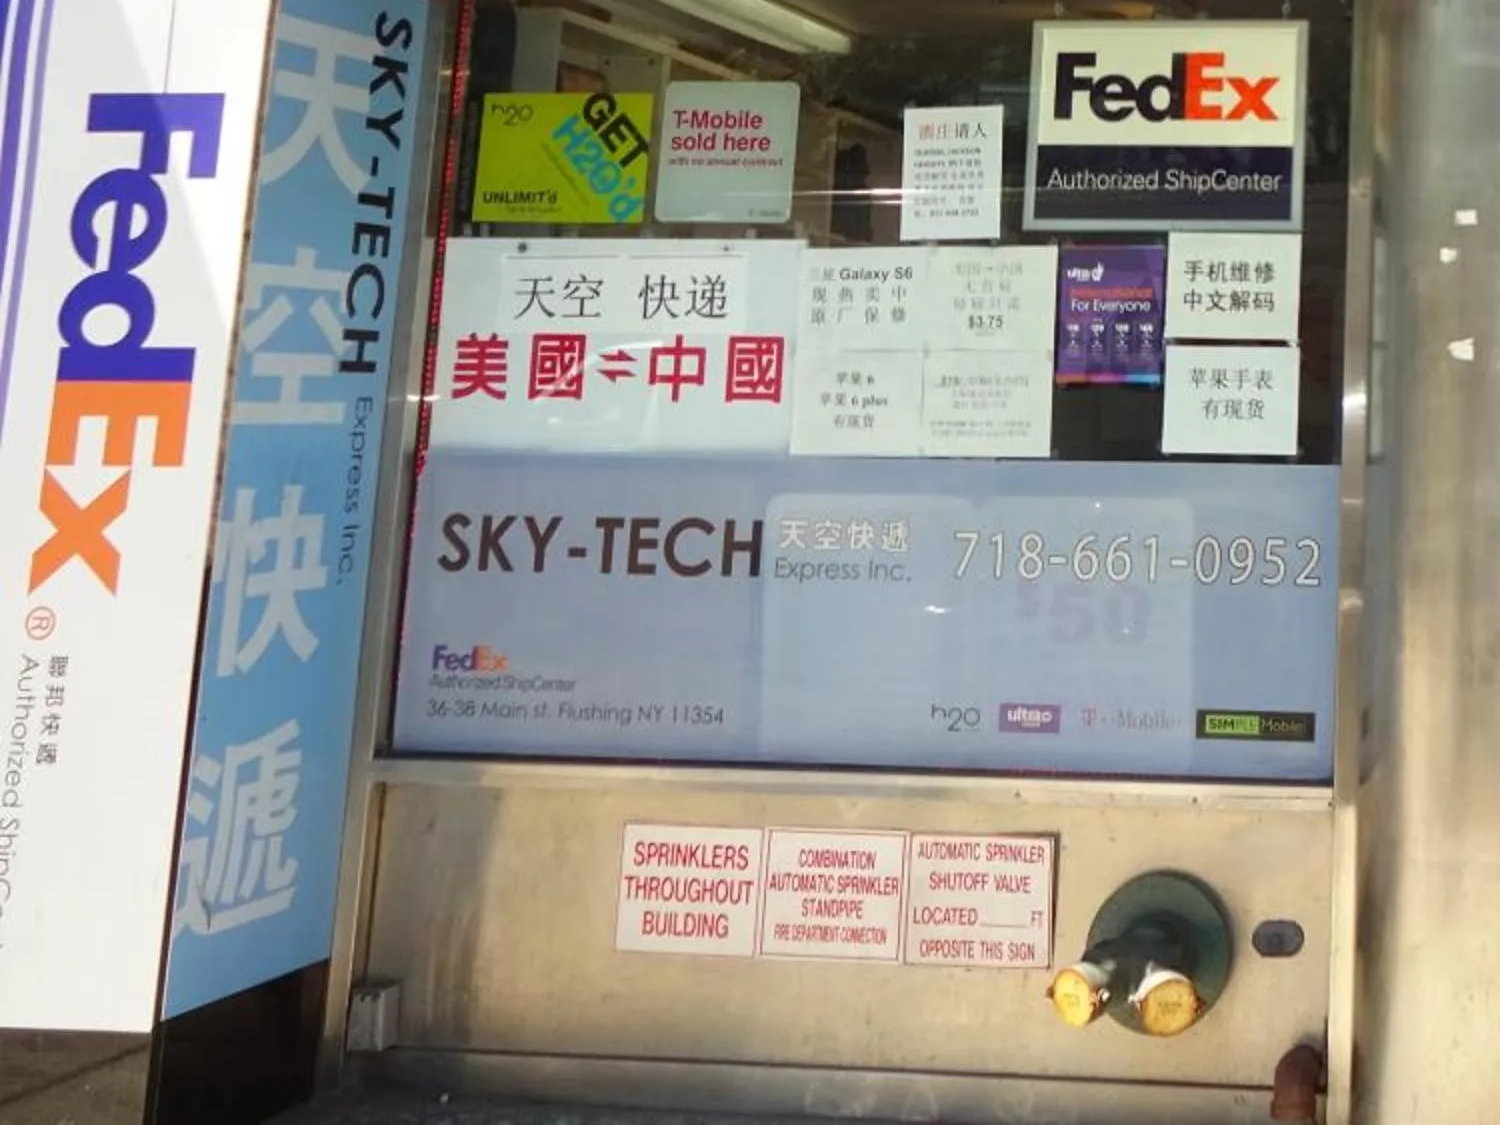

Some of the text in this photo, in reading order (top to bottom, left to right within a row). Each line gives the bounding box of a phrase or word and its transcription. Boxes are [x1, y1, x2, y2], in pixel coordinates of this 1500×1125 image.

[1054, 51, 1280, 123] FedEx
[582, 91, 649, 168] GET
[672, 110, 763, 130] T-Mobile
[671, 133, 771, 152] sold here
[1047, 167, 1282, 194] Authorized ShipCenter
[839, 267, 889, 283] Galaxy
[894, 266, 913, 281] S6
[1183, 260, 1275, 284] 手机维修
[336, 10, 412, 586] SKY-TECH Express Inc.
[514, 273, 729, 321] 天空 快递
[1071, 298, 1152, 315] For Everyone
[1183, 289, 1275, 312] 中文解码
[28, 93, 226, 597] FedEx
[452, 331, 786, 404] 美國 中國
[1188, 367, 1273, 391] 苹果手表
[861, 394, 889, 409] plus
[1202, 398, 1265, 420] 有现货
[171, 14, 378, 938] 天空快遞
[437, 512, 764, 578] SKY-TECH
[778, 518, 910, 554] 天空快遞
[773, 556, 913, 583] Express Inc.
[953, 531, 1322, 587] 718-661-0952
[431, 644, 508, 672] FedEx
[427, 674, 577, 692] Authorized ShipCenter
[425, 699, 725, 727] 36-38 Main st. Flushing NY 11354
[2, 653, 41, 808] Authorized
[633, 840, 750, 870] SPRINKLERS
[799, 848, 877, 869] COMBINATION
[917, 841, 1045, 865] AUTOMATIC SPRINKLER
[624, 876, 754, 905] THROUGHOUT
[769, 873, 899, 897] AUTOMATIC SPRINKLER
[928, 871, 1031, 894] SHUTOFF VALVE
[801, 897, 863, 921] STANDPIPE
[913, 906, 1044, 929] LOCATED FT
[641, 910, 729, 940] BUILDING
[919, 938, 1036, 962] OPPOSITE THIS SIGN
